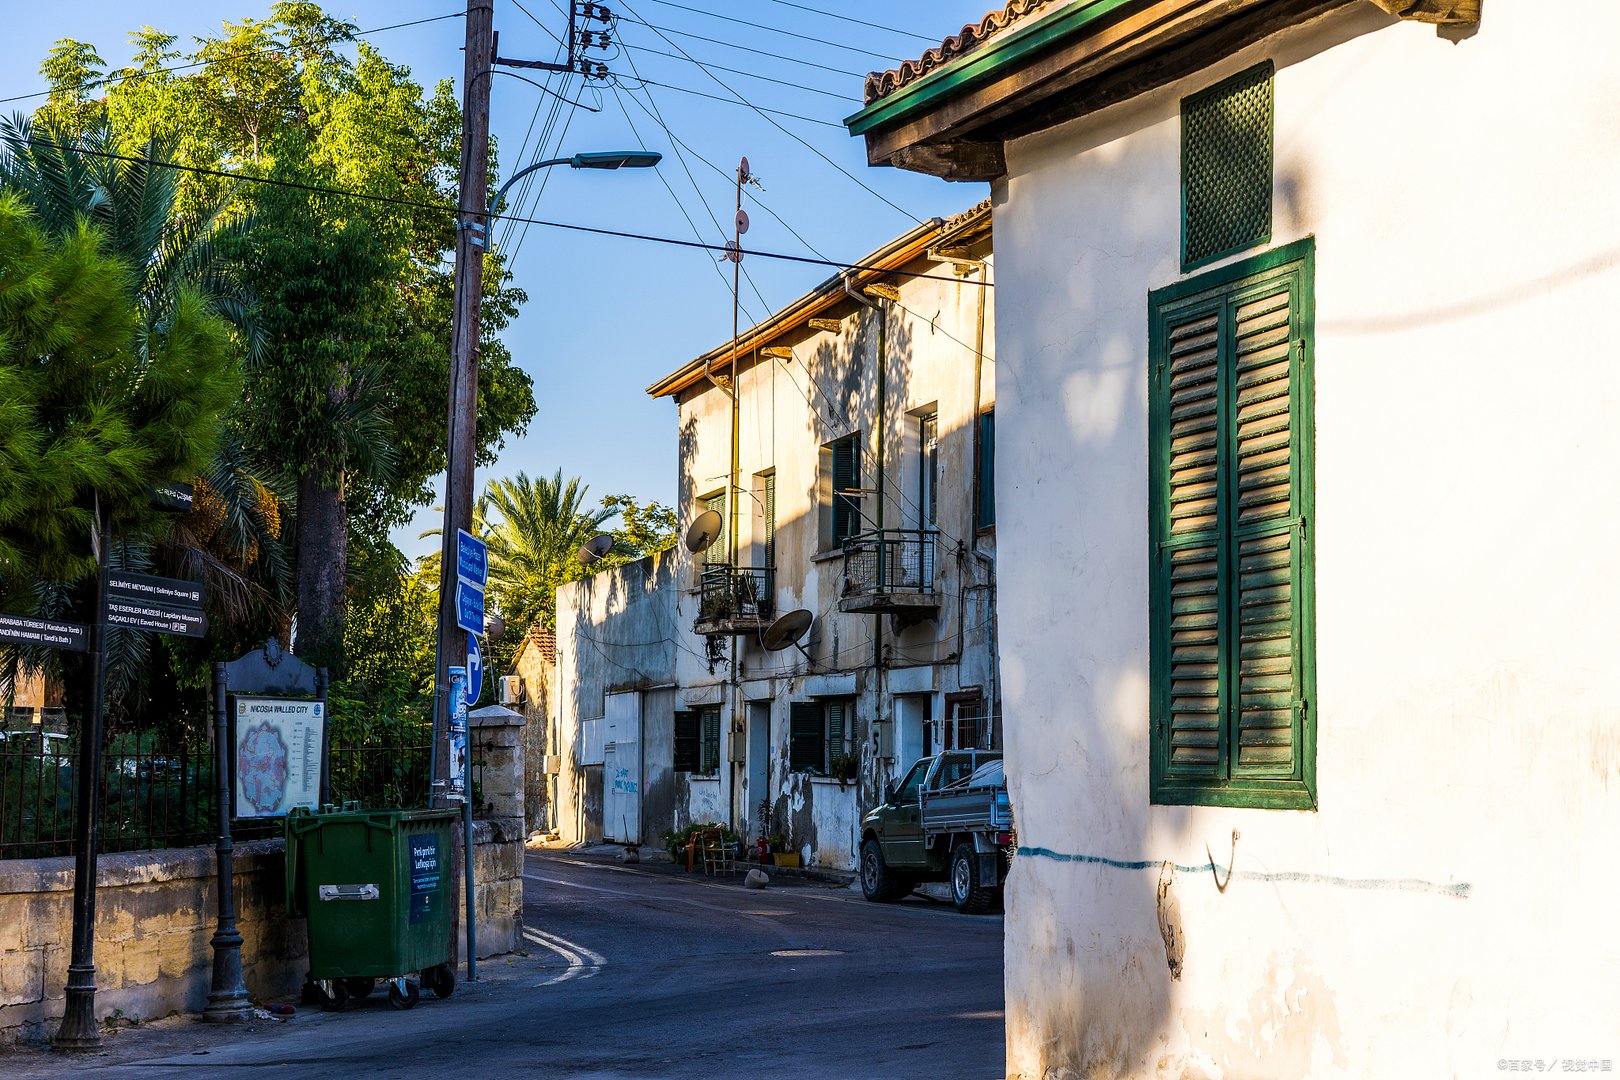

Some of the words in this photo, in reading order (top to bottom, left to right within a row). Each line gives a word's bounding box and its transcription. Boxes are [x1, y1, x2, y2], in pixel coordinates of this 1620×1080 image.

[109, 580, 131, 590] SELİMİYE
[132, 583, 153, 593] MEYDANI
[108, 603, 118, 613] TAŞ
[118, 605, 142, 614] ESERLER
[142, 608, 160, 617] MÜZESİ
[0, 617, 23, 627] ARABABA
[23, 620, 44, 629] TÜRBESİ
[108, 614, 129, 623] SAÇAKLI
[0, 629, 21, 638] ANDİ'NİN
[21, 631, 40, 640] HAMAMI
[296, 706, 309, 714] CITY
